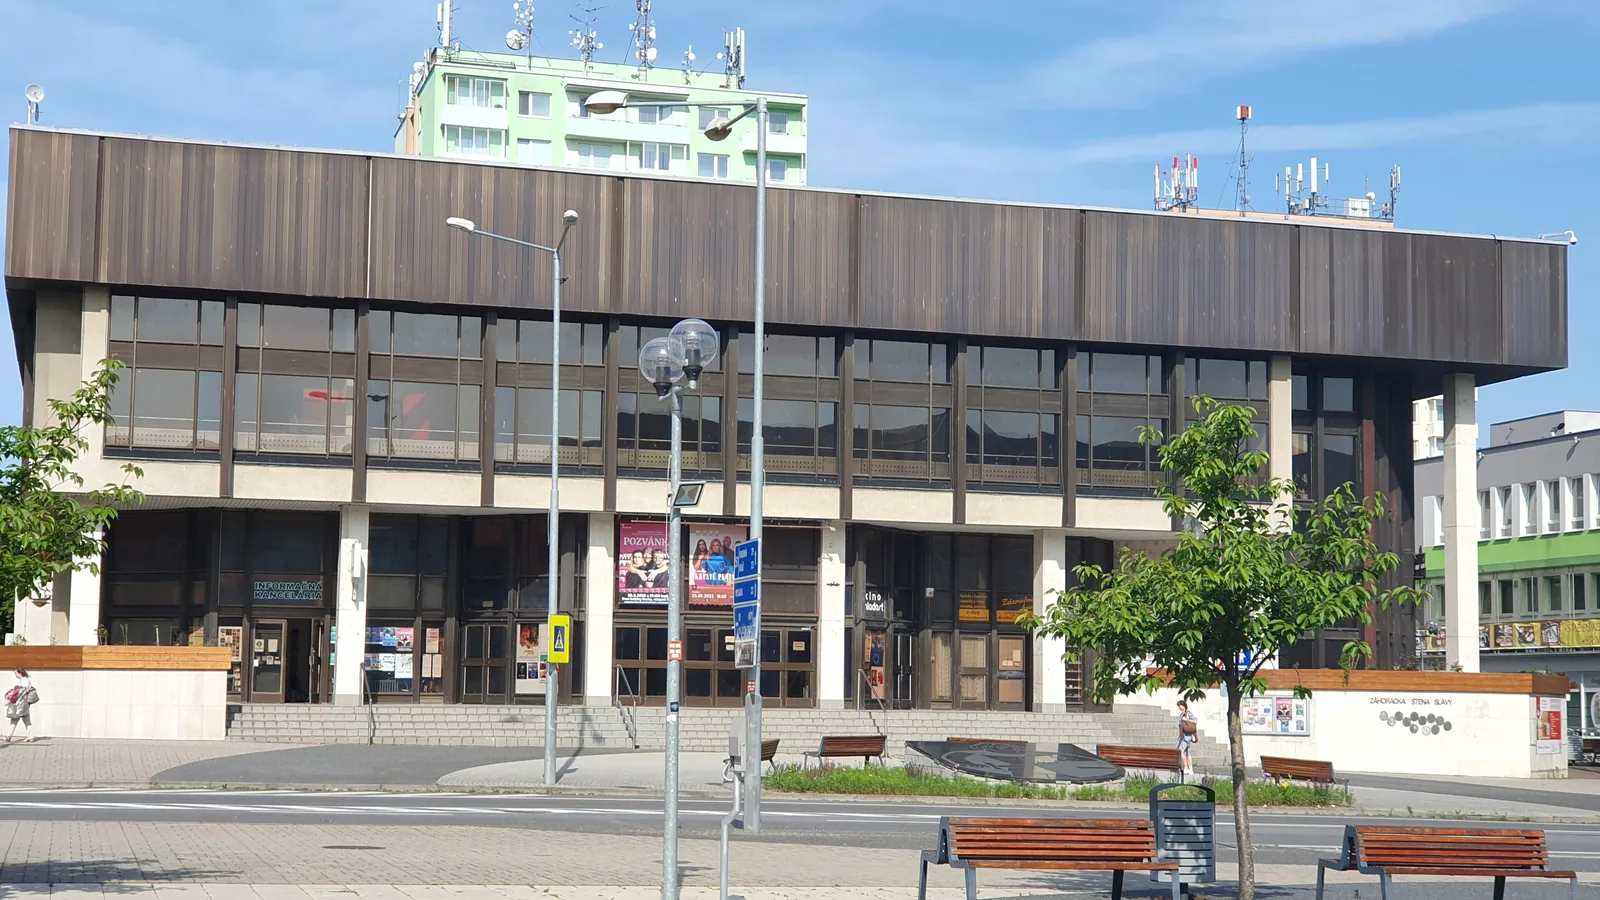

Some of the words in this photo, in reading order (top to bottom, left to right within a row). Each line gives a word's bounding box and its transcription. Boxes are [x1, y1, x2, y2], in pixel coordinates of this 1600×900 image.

[623, 536, 669, 546] POZVÁNK
[254, 580, 323, 591] INFORMAČNÁ
[254, 590, 323, 600] KANCELÁRIA
[1370, 696, 1406, 704] ZÁHORÁCKA
[1434, 697, 1452, 705] SLÁVY
